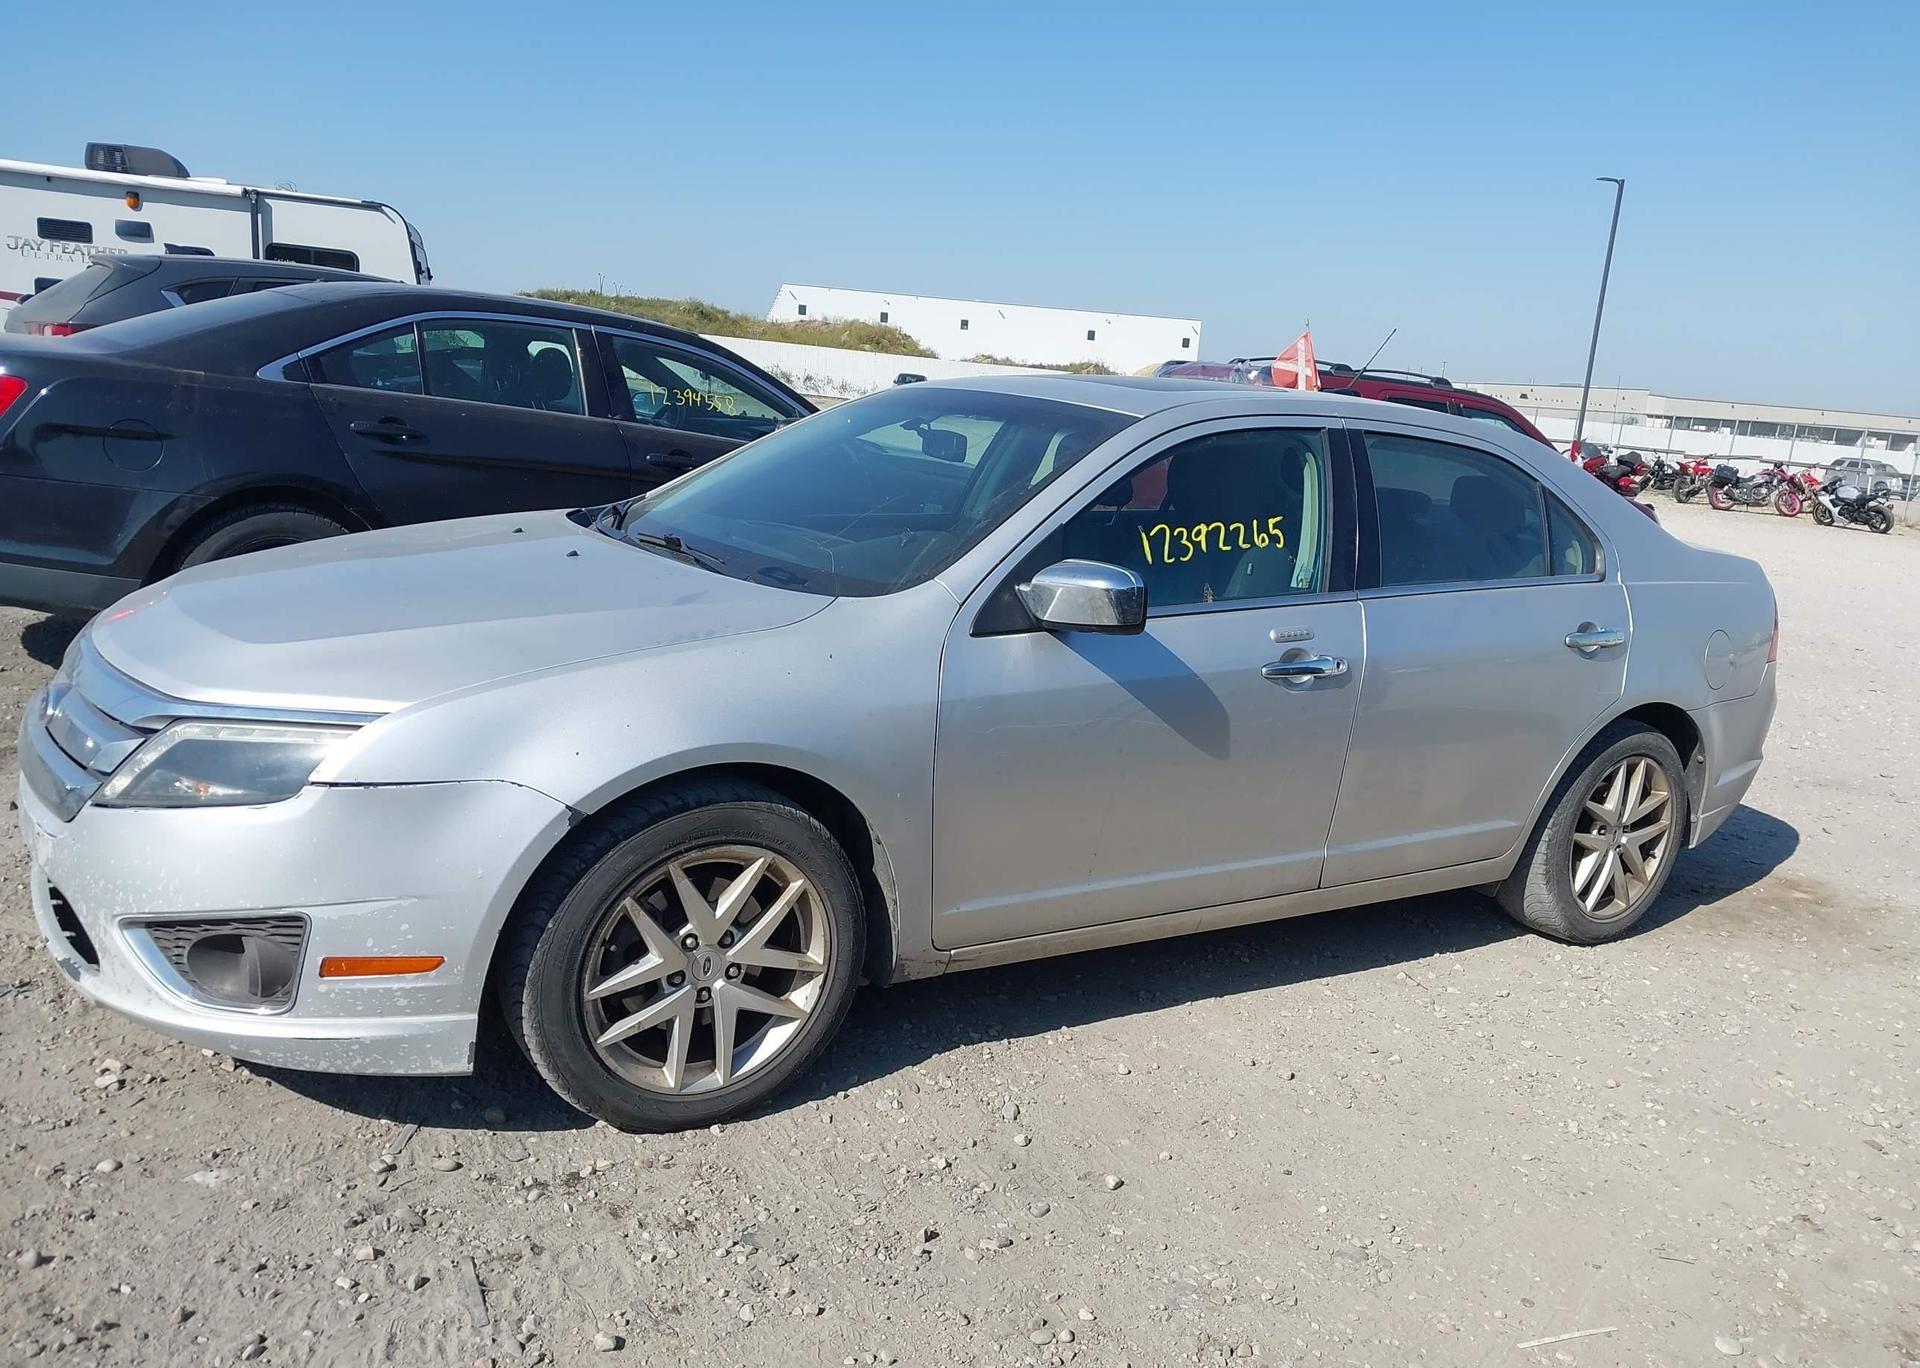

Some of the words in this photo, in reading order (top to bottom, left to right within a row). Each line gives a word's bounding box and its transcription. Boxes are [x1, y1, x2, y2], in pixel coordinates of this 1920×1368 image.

[6, 235, 46, 252] JAY
[20, 248, 74, 263] ULTRA
[651, 386, 737, 416] 12394558
[1138, 515, 1285, 564] 12392265
